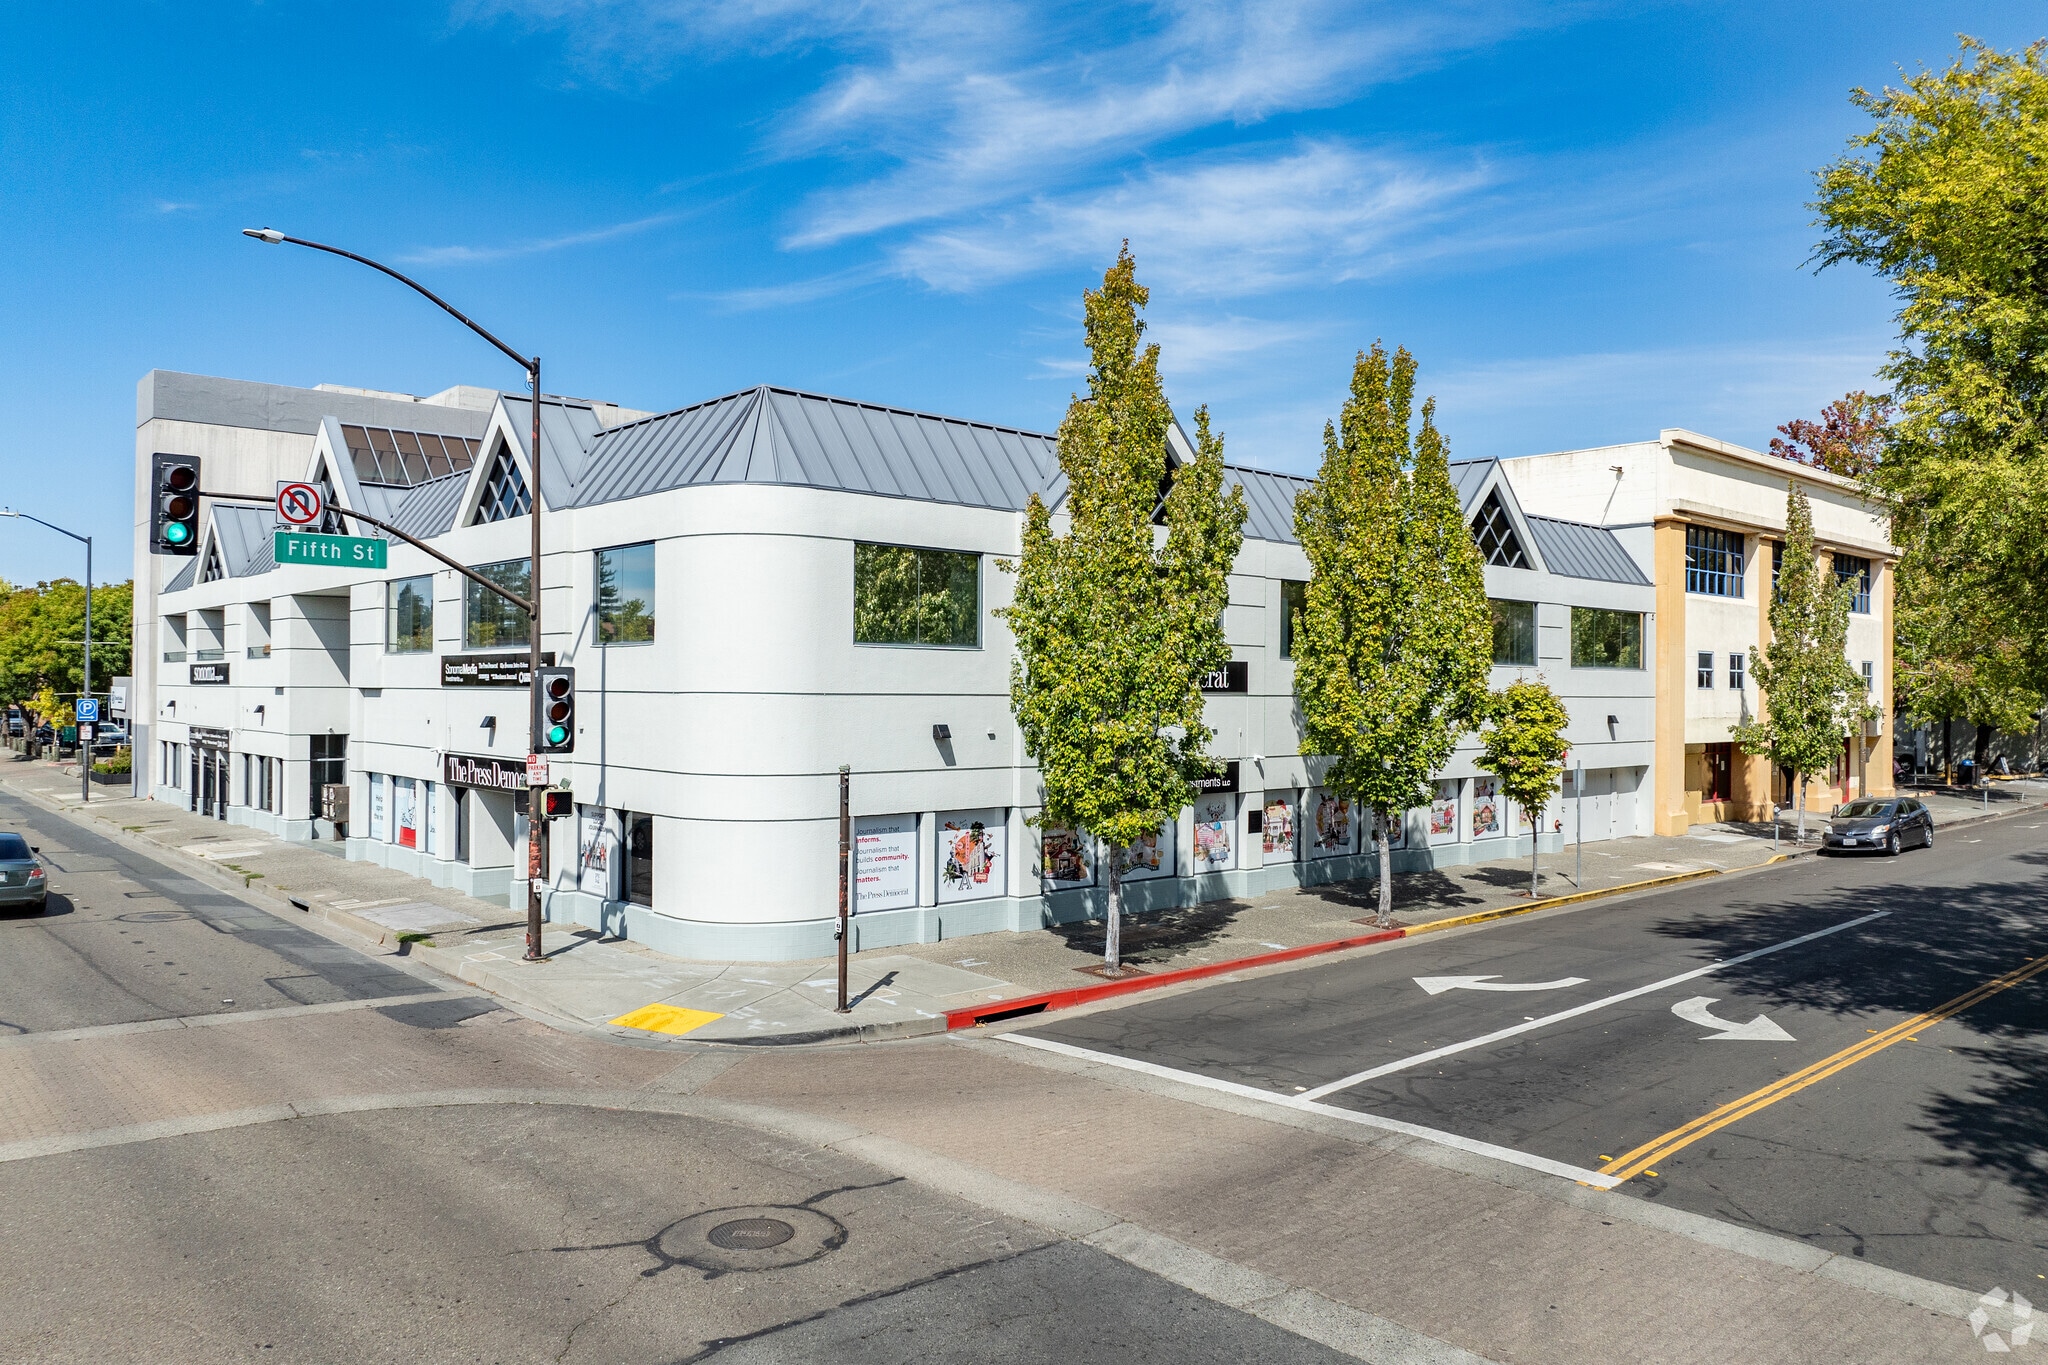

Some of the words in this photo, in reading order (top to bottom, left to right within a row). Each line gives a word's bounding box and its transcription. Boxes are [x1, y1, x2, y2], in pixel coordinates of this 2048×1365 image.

[288, 540, 341, 559] Fifth
[353, 544, 375, 561] St
[1199, 665, 1230, 689] crat
[448, 757, 467, 783] The
[467, 759, 492, 786] Press
[856, 827, 887, 835] Journalism
[856, 847, 887, 855] Journalism
[856, 856, 874, 864] builds
[874, 853, 909, 862] community.
[856, 866, 887, 875] Journalism
[856, 876, 881, 884] matters.
[857, 892, 867, 900] The
[867, 891, 883, 899] Press
[883, 888, 909, 898] Democrat
